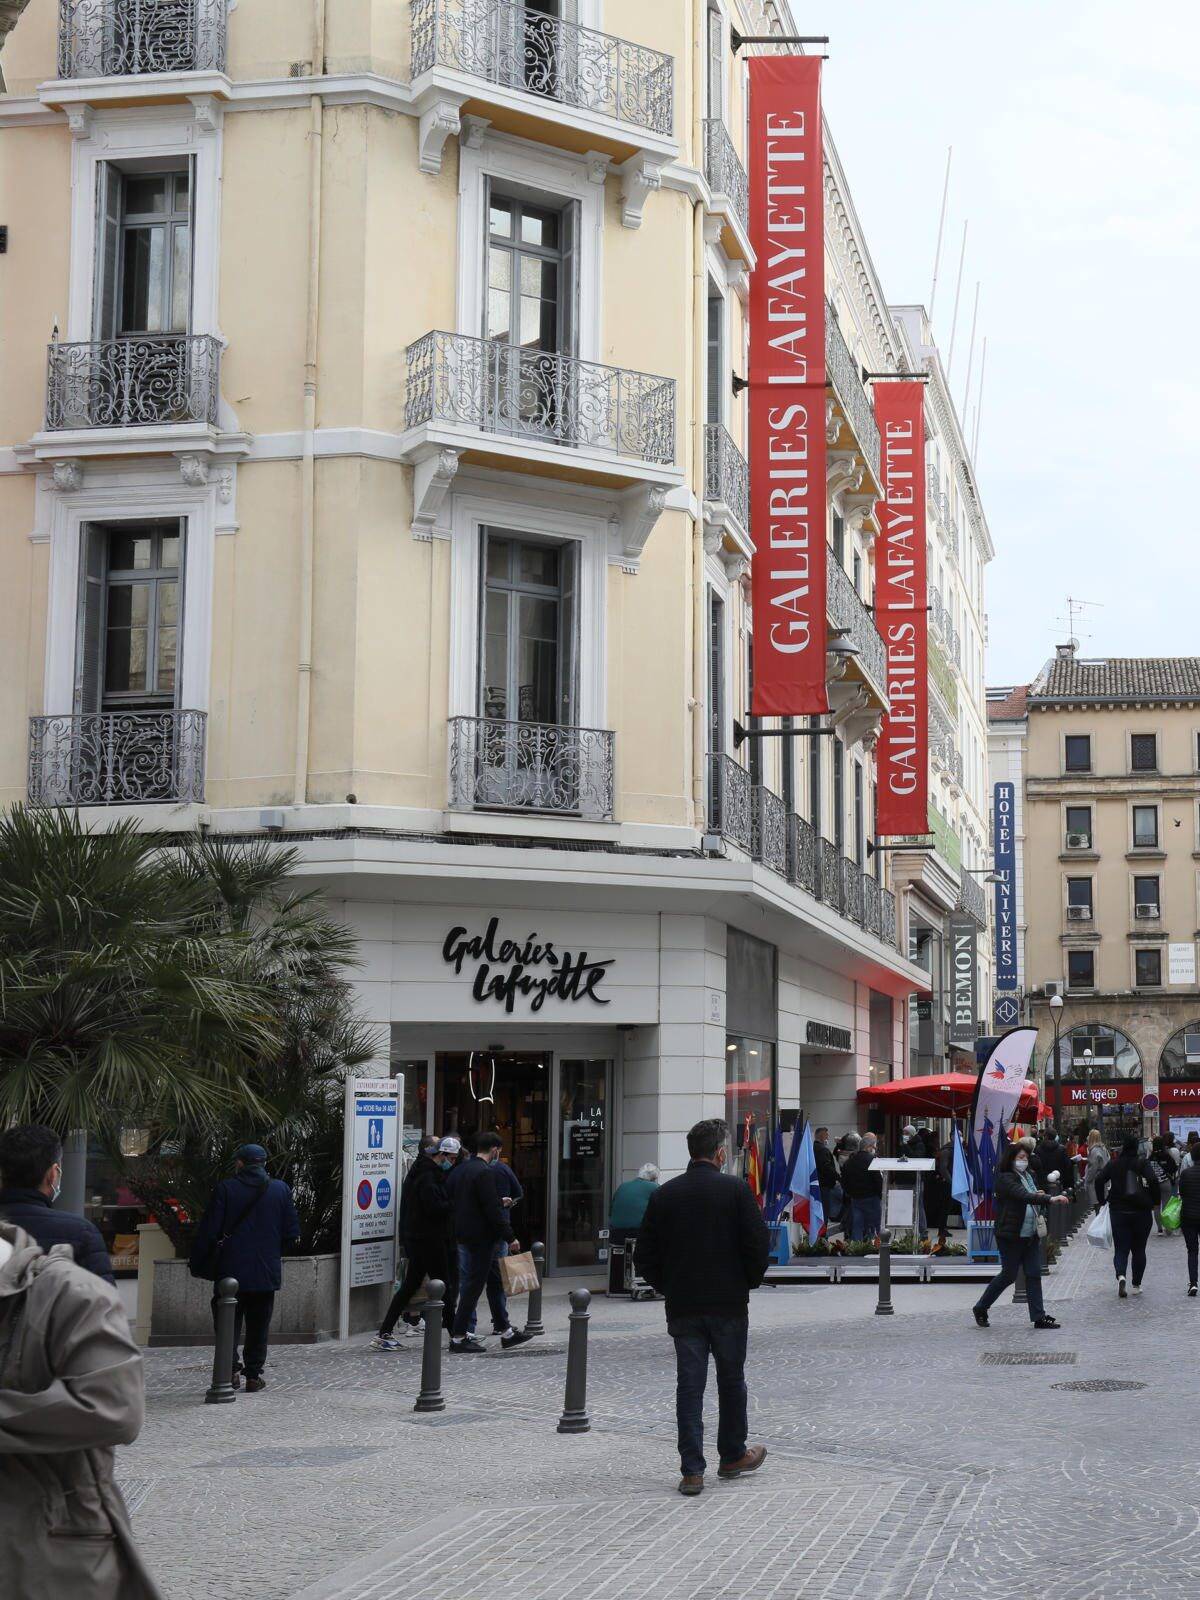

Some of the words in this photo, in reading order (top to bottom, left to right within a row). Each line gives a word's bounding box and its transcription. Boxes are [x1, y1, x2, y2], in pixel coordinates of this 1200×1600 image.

[766, 111, 808, 385] LAFAYETTE
[768, 404, 811, 654] GALERIES
[885, 419, 915, 610] LAFAYETTE
[887, 622, 917, 795] GALERIES
[999, 787, 1010, 854] HOTEL
[442, 917, 559, 974] Galeries
[1000, 869, 1013, 966] UNIVERS
[473, 951, 616, 1013] Lafayette
[955, 934, 972, 1026] BEMON
[355, 1152, 369, 1162] ZONE
[371, 1151, 394, 1161] PIETONNE
